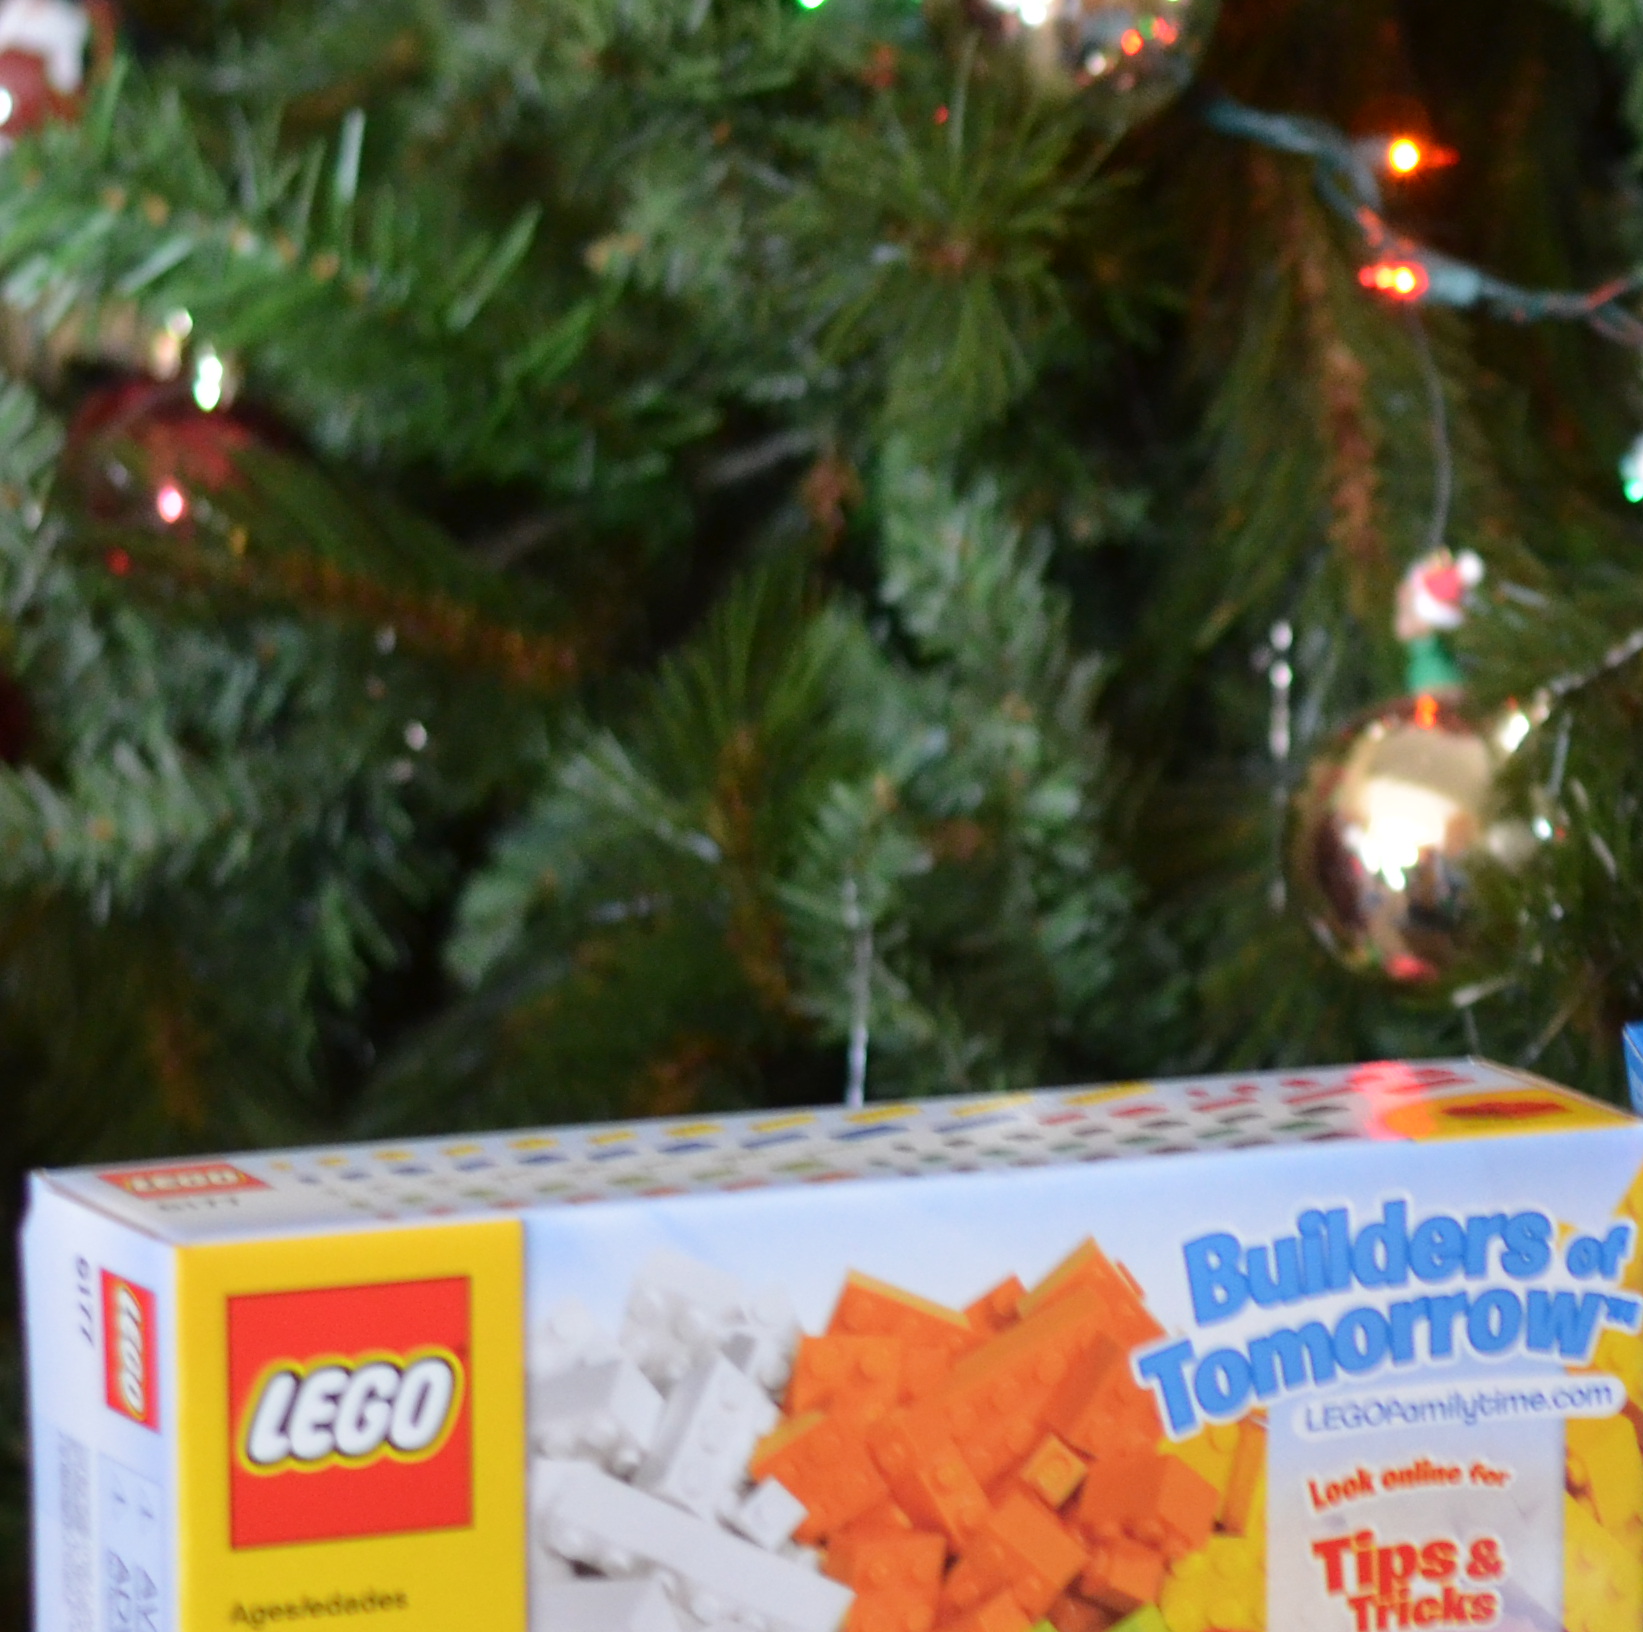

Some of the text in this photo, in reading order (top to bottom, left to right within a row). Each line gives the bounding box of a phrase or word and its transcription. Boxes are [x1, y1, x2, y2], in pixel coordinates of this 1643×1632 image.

[75, 1255, 96, 1348] 6177
[1182, 1198, 1632, 1325] Builders of
[116, 1283, 145, 1418] LEGO
[243, 1353, 459, 1468] LEGO
[1305, 1382, 1615, 1434] LEGOFamilytime.com
[1308, 1458, 1512, 1513] Look online for
[1311, 1528, 1505, 1597] Tips &
[231, 1585, 408, 1630] Ages/edades
